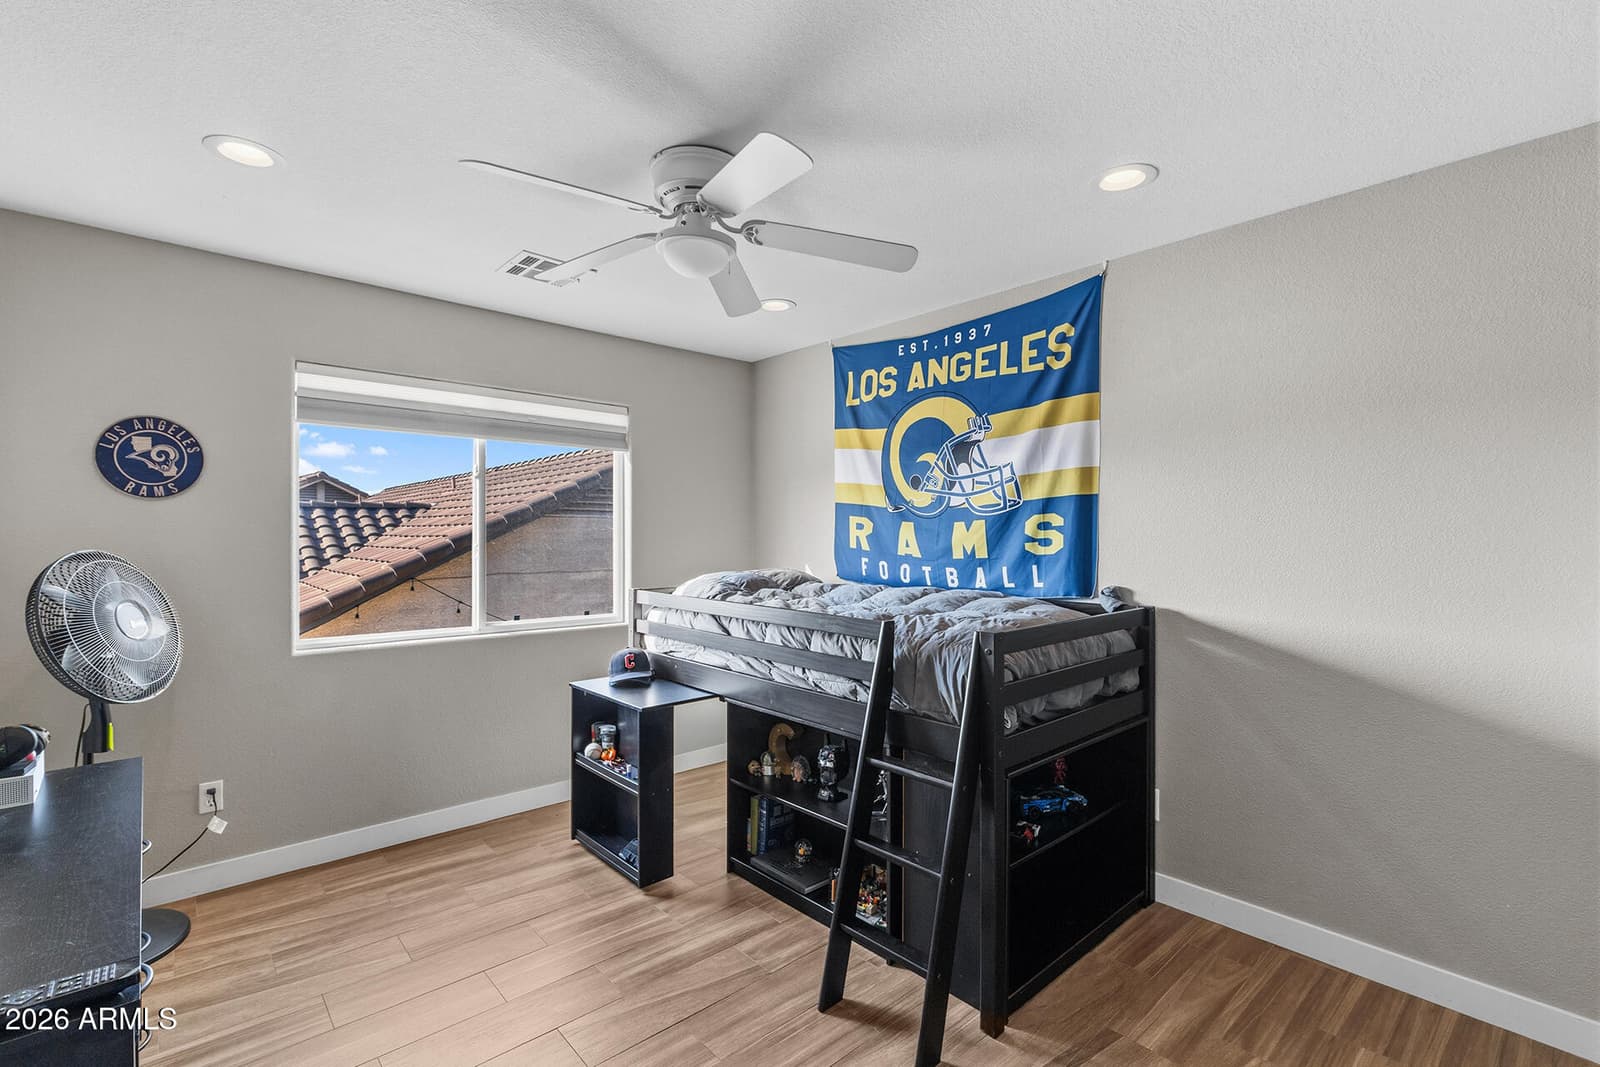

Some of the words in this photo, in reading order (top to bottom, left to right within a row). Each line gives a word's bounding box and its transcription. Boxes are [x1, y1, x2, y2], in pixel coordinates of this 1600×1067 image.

[845, 367, 897, 407] LOS
[907, 322, 1075, 392] ANGELES
[99, 425, 127, 449] LOS
[133, 418, 200, 453] ANGELES
[124, 481, 178, 497] RAMS
[849, 513, 1065, 559] RAMS
[861, 557, 1044, 588] FOOTBALL
[624, 653, 636, 669] C
